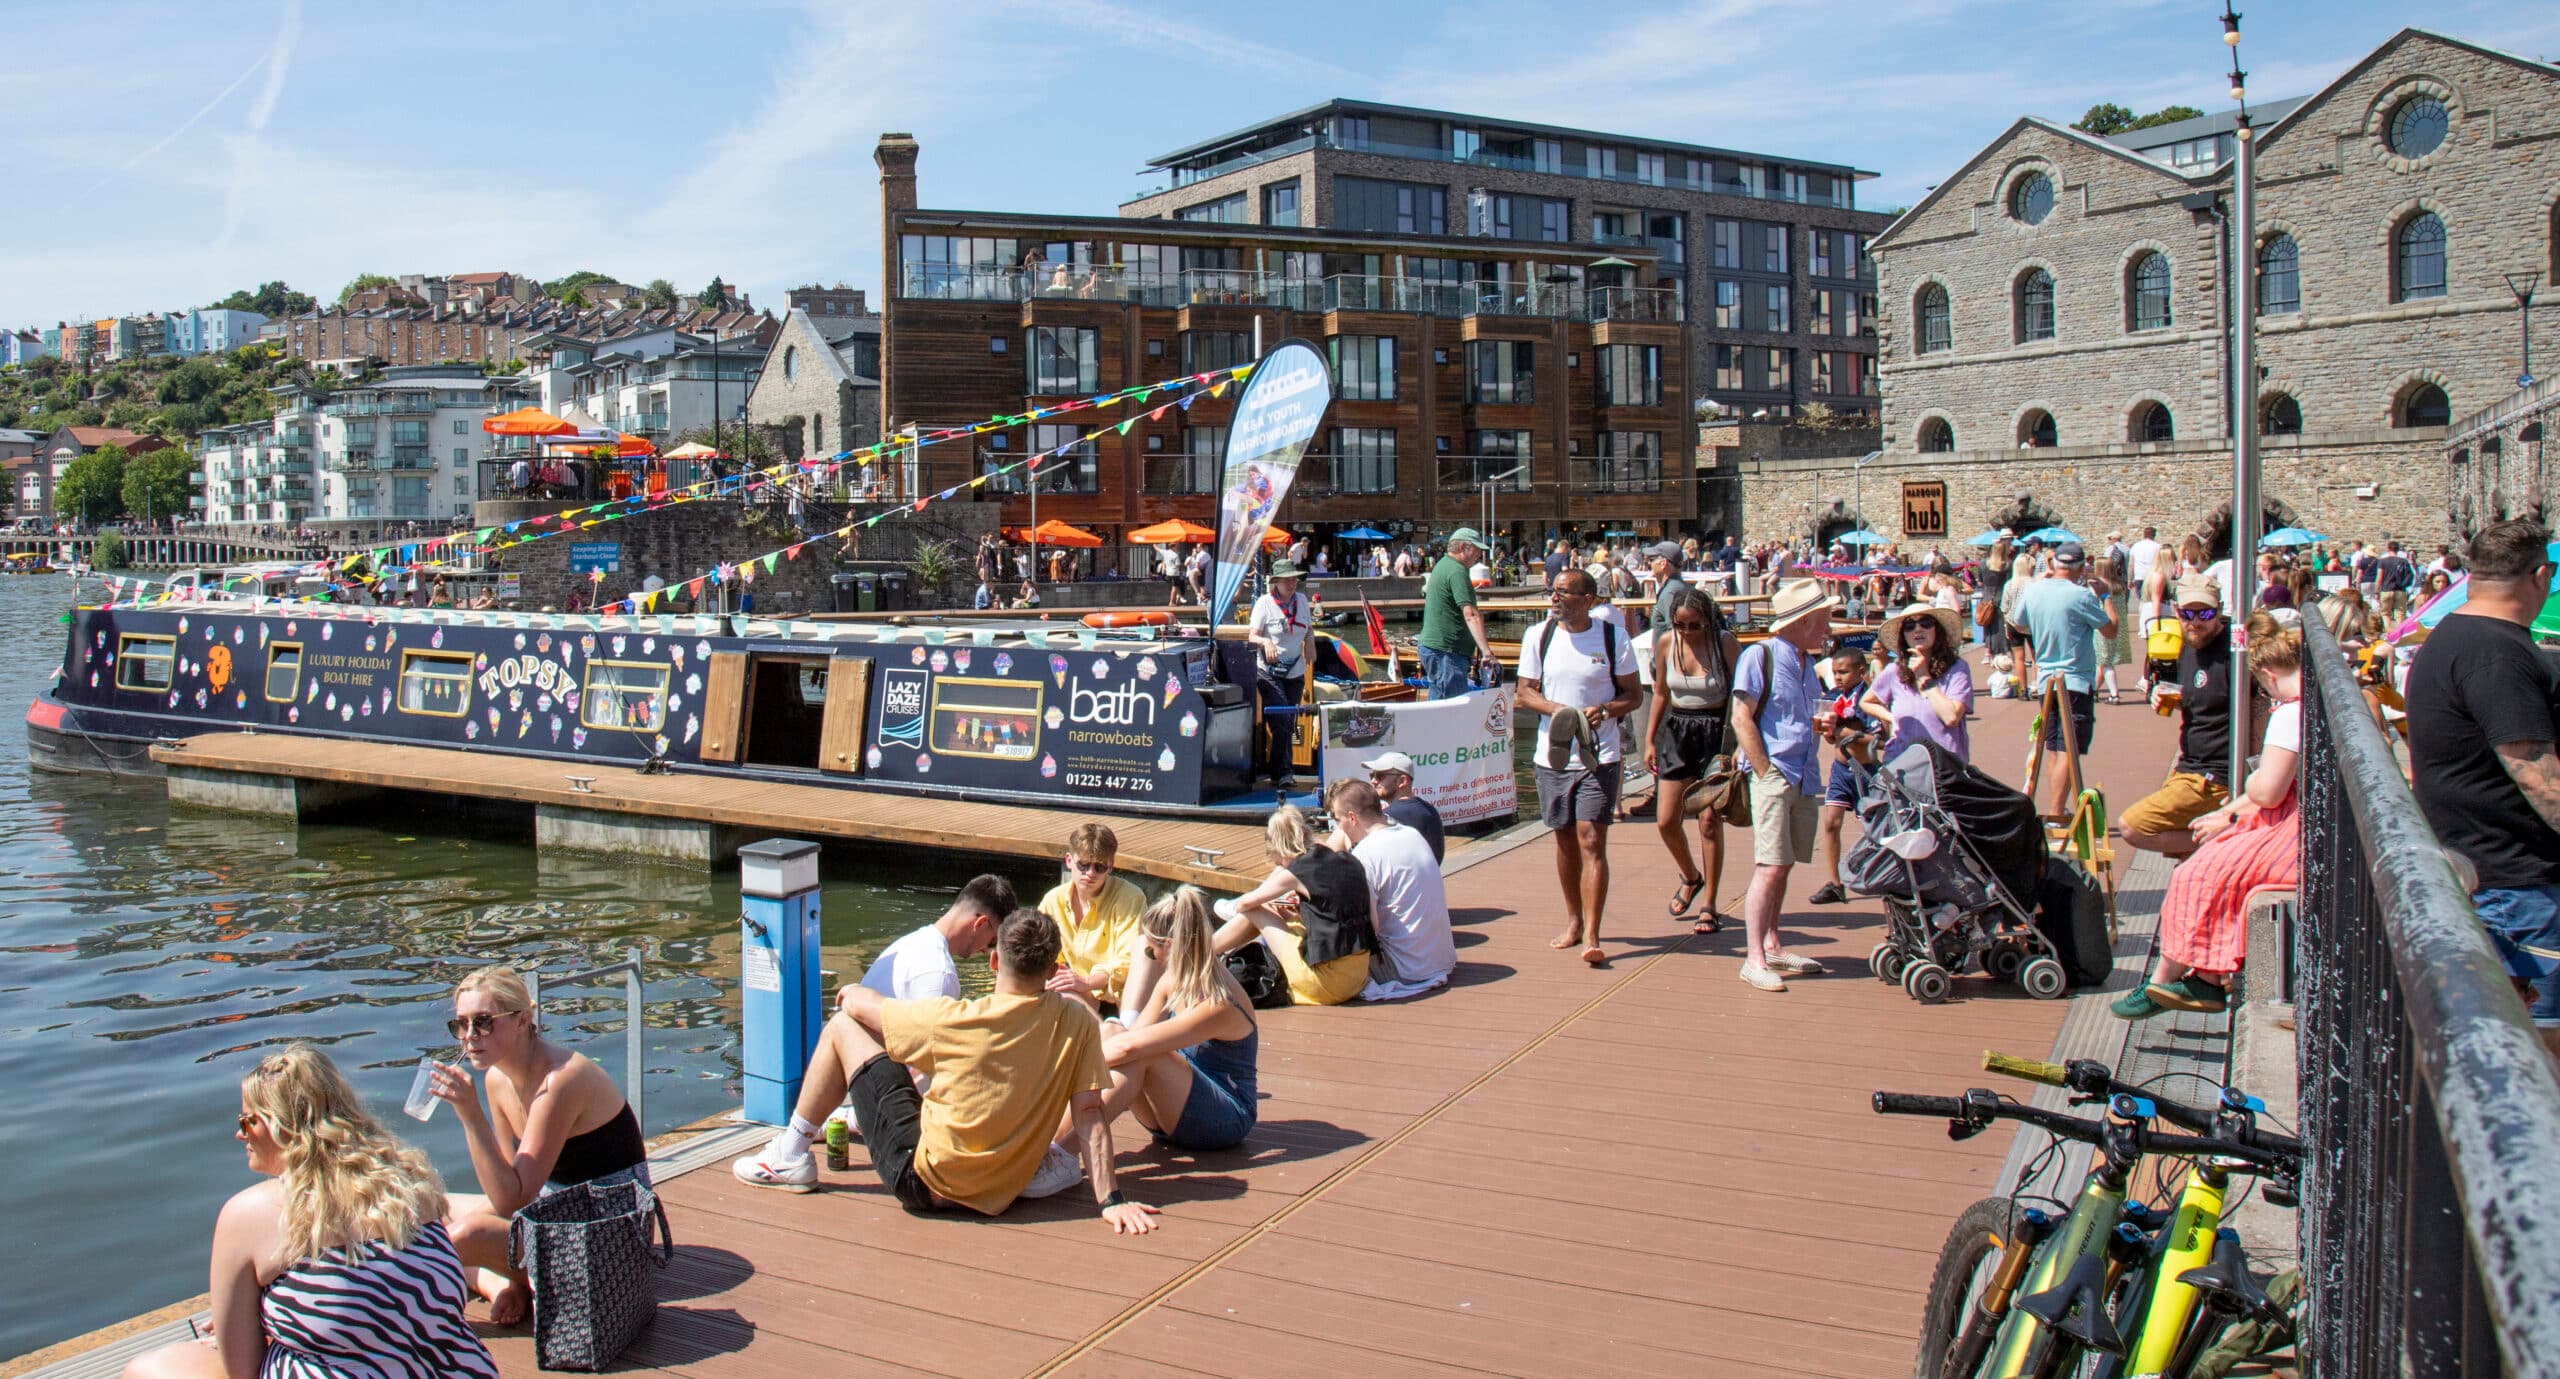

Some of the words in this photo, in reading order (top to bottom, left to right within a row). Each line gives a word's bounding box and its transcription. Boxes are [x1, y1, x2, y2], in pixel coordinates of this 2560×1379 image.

[1243, 415, 1265, 432] K&A
[1267, 401, 1302, 424] YOUTH
[1232, 412, 1318, 456] NARROWBOATING
[1906, 488, 1941, 498] HARBOUR
[1907, 500, 1941, 530] hub
[309, 654, 347, 668] LUXURY
[348, 656, 393, 670] HOLIDAY
[323, 671, 350, 685] BOAT
[351, 674, 373, 687] HIRE
[478, 655, 577, 703] TOPSY
[888, 680, 921, 694] LAZY
[887, 693, 921, 706] DAZE
[1070, 676, 1155, 725] bath
[886, 705, 920, 715] CRUISES
[1068, 729, 1154, 747] narrowboats
[1066, 773, 1102, 787] 01225
[1105, 776, 1128, 789] 447
[1130, 778, 1153, 791] 276
[1421, 786, 1436, 796] us,
